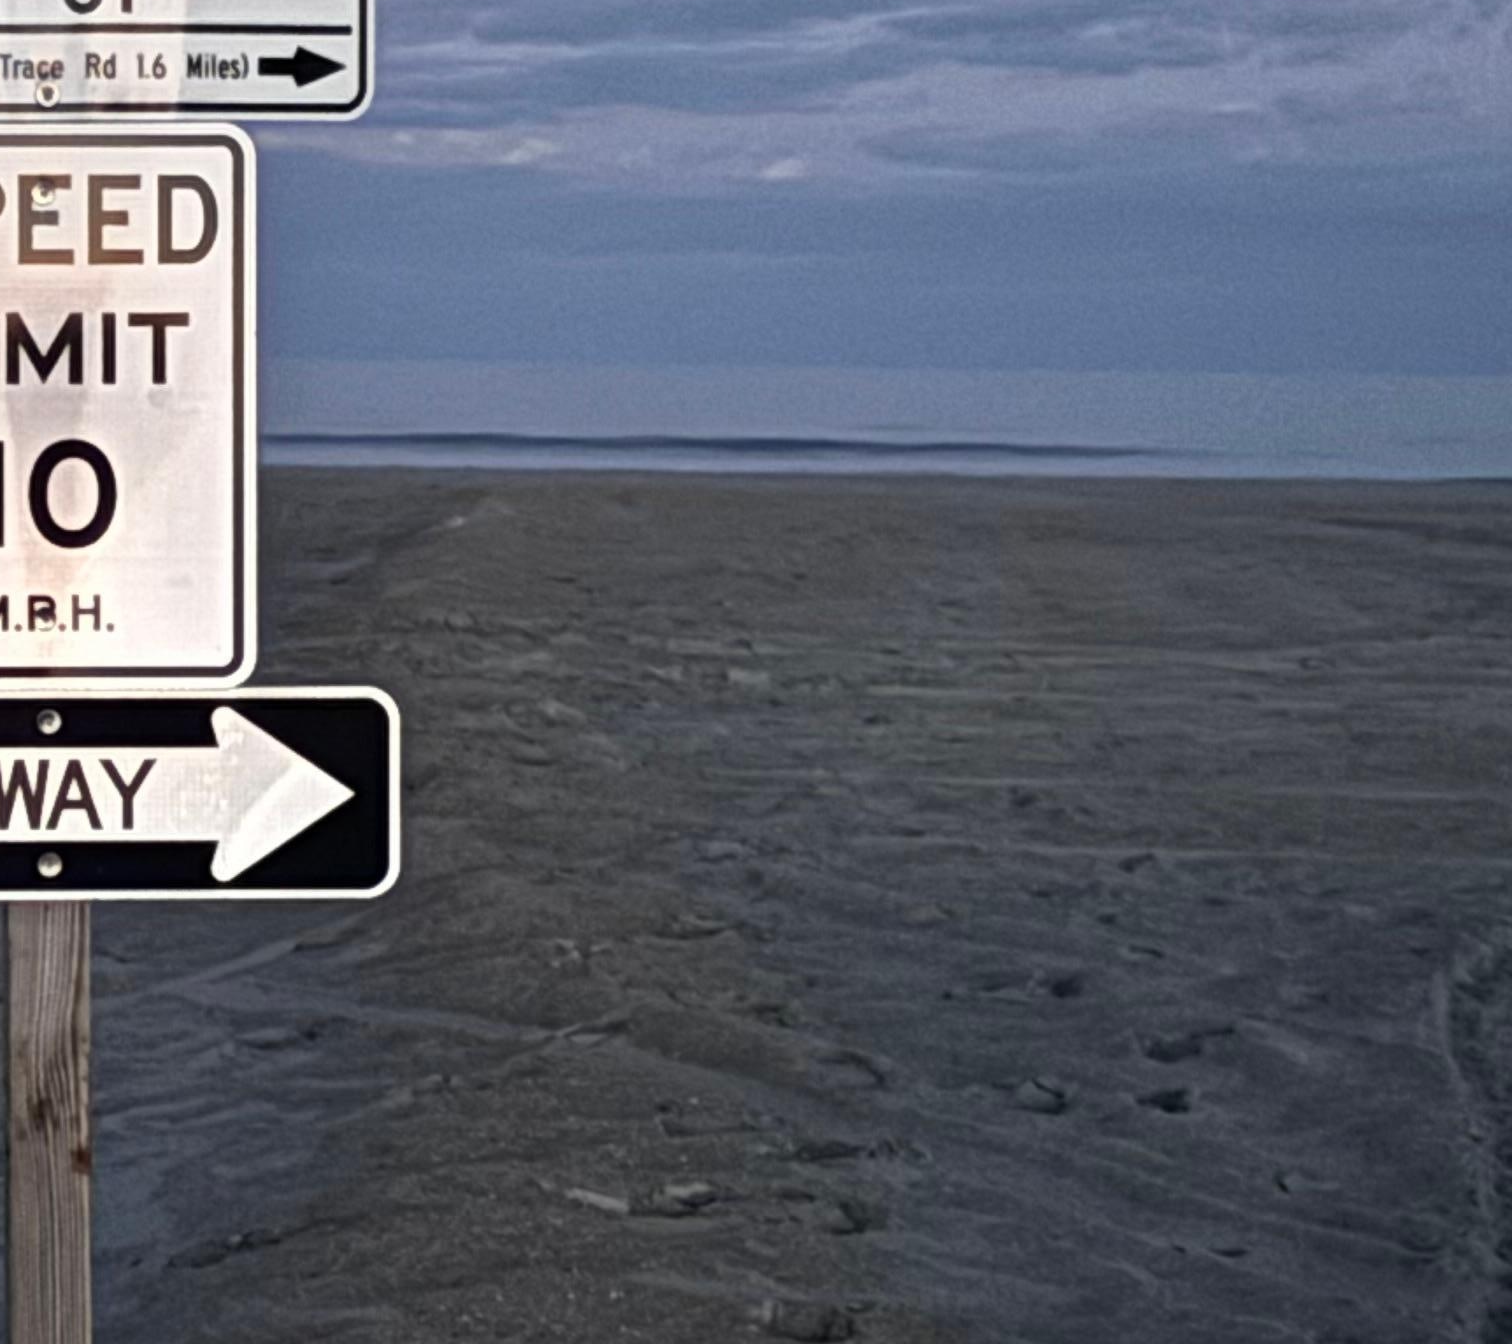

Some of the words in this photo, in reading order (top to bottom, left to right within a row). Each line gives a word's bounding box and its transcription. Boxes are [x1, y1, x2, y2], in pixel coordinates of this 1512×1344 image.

[0, 53, 64, 80] Trace
[84, 53, 116, 80] Rd
[137, 53, 167, 80] 1.6
[186, 53, 249, 80] Miles)
